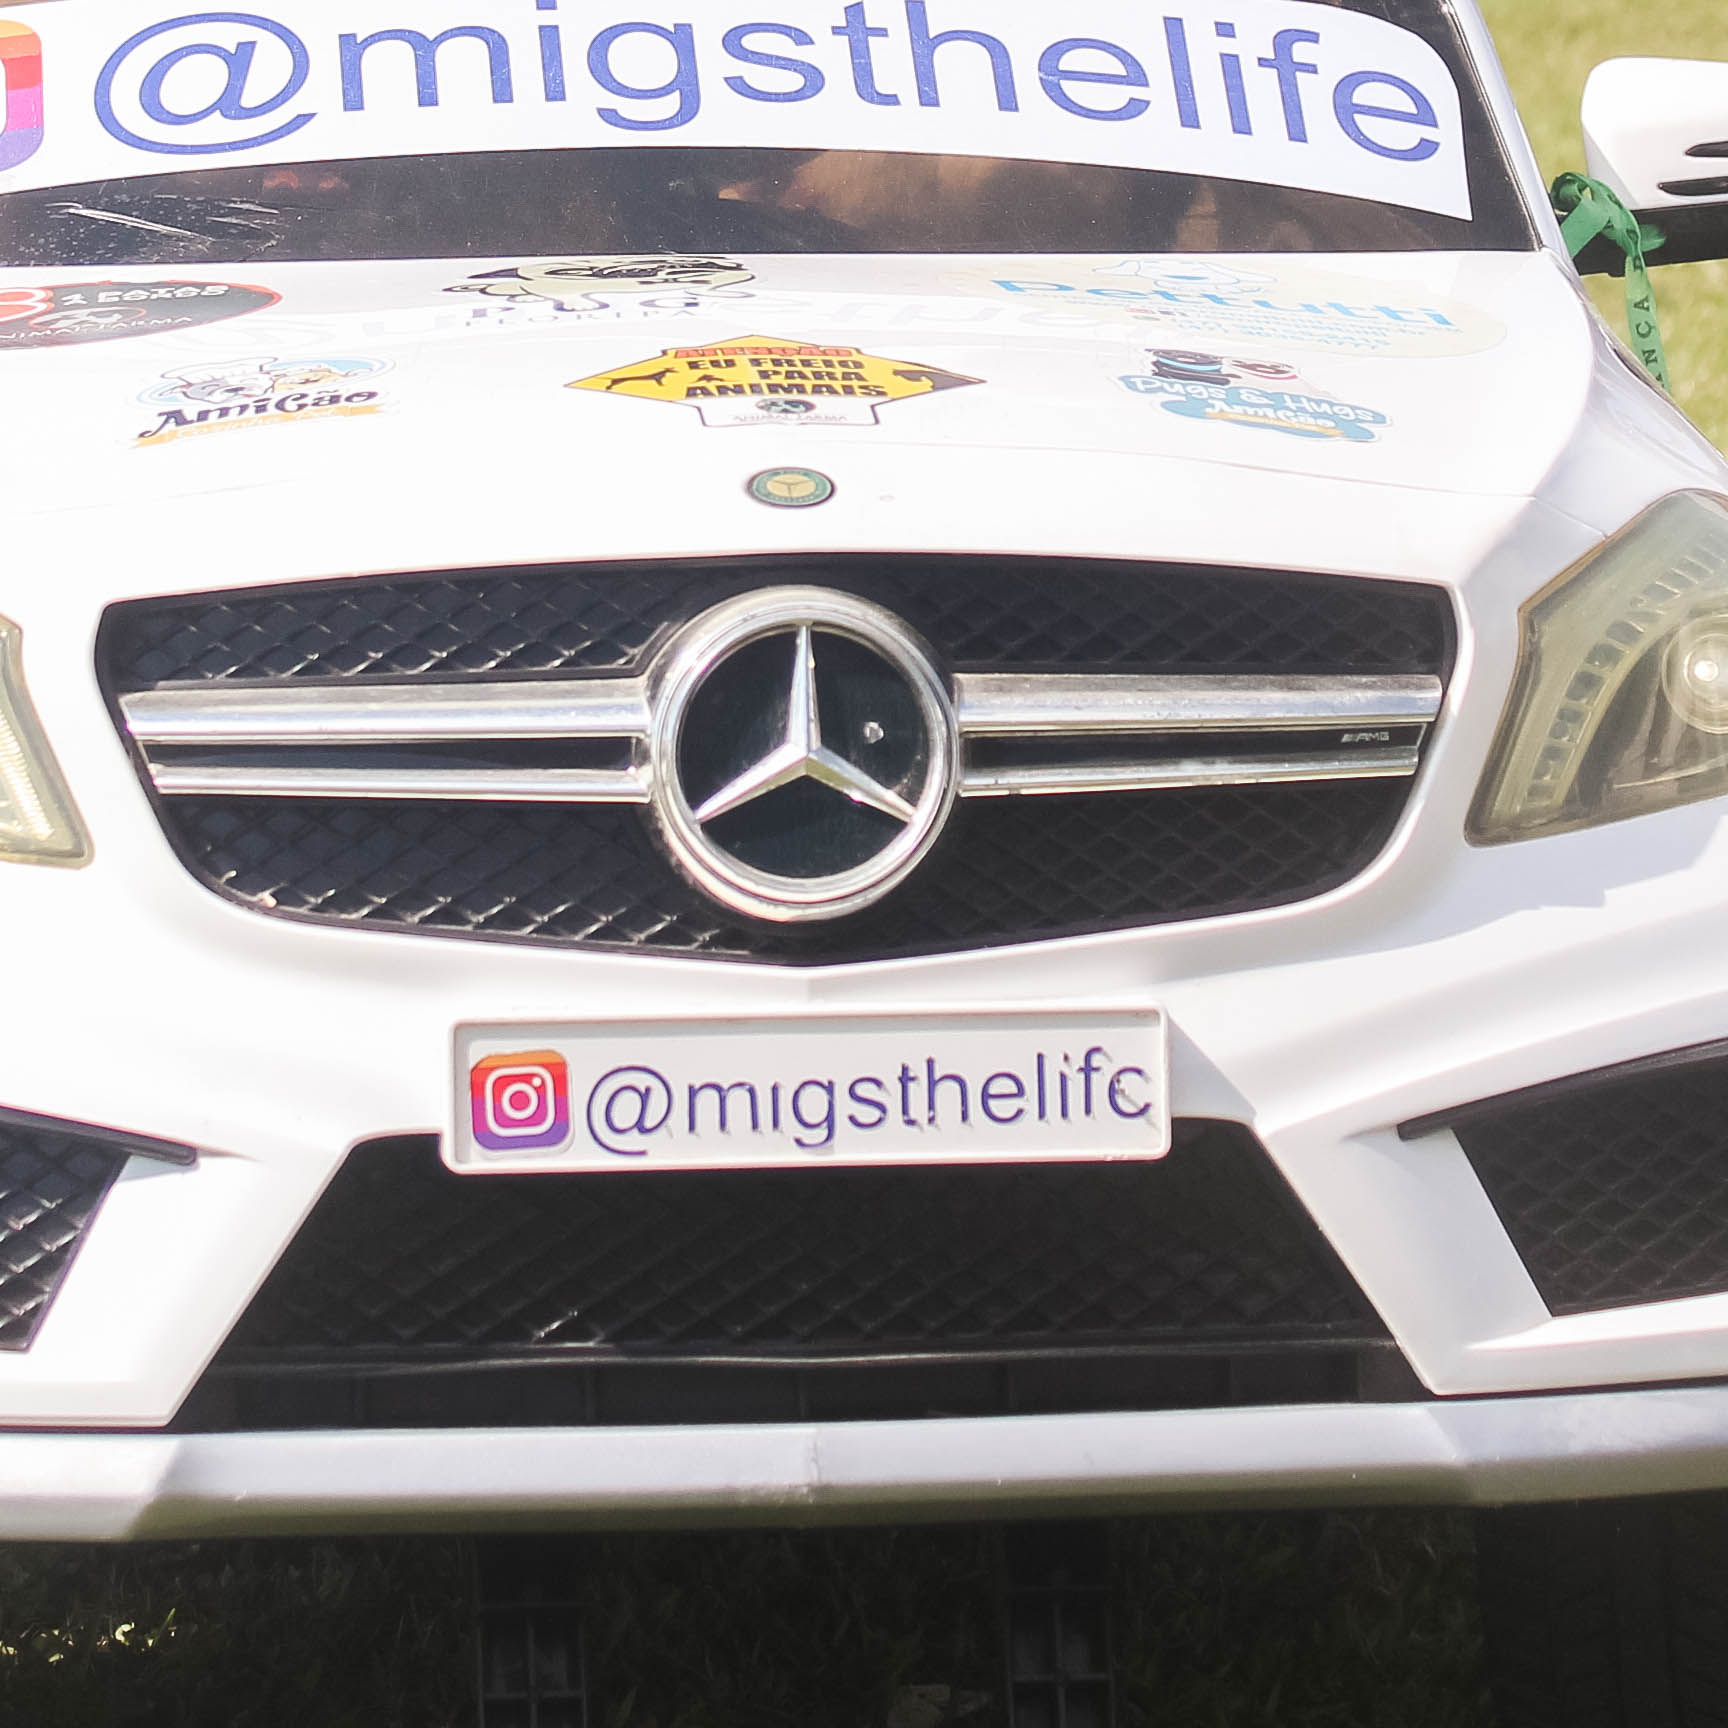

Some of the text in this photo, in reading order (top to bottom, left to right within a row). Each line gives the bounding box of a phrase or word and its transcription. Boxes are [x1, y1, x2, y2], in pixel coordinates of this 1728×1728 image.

[686, 358, 865, 370] EU FREIO
[757, 369, 868, 382] PARA
[685, 383, 889, 398] ANIMAIS
[1129, 376, 1376, 422] Pugs & Hugs
